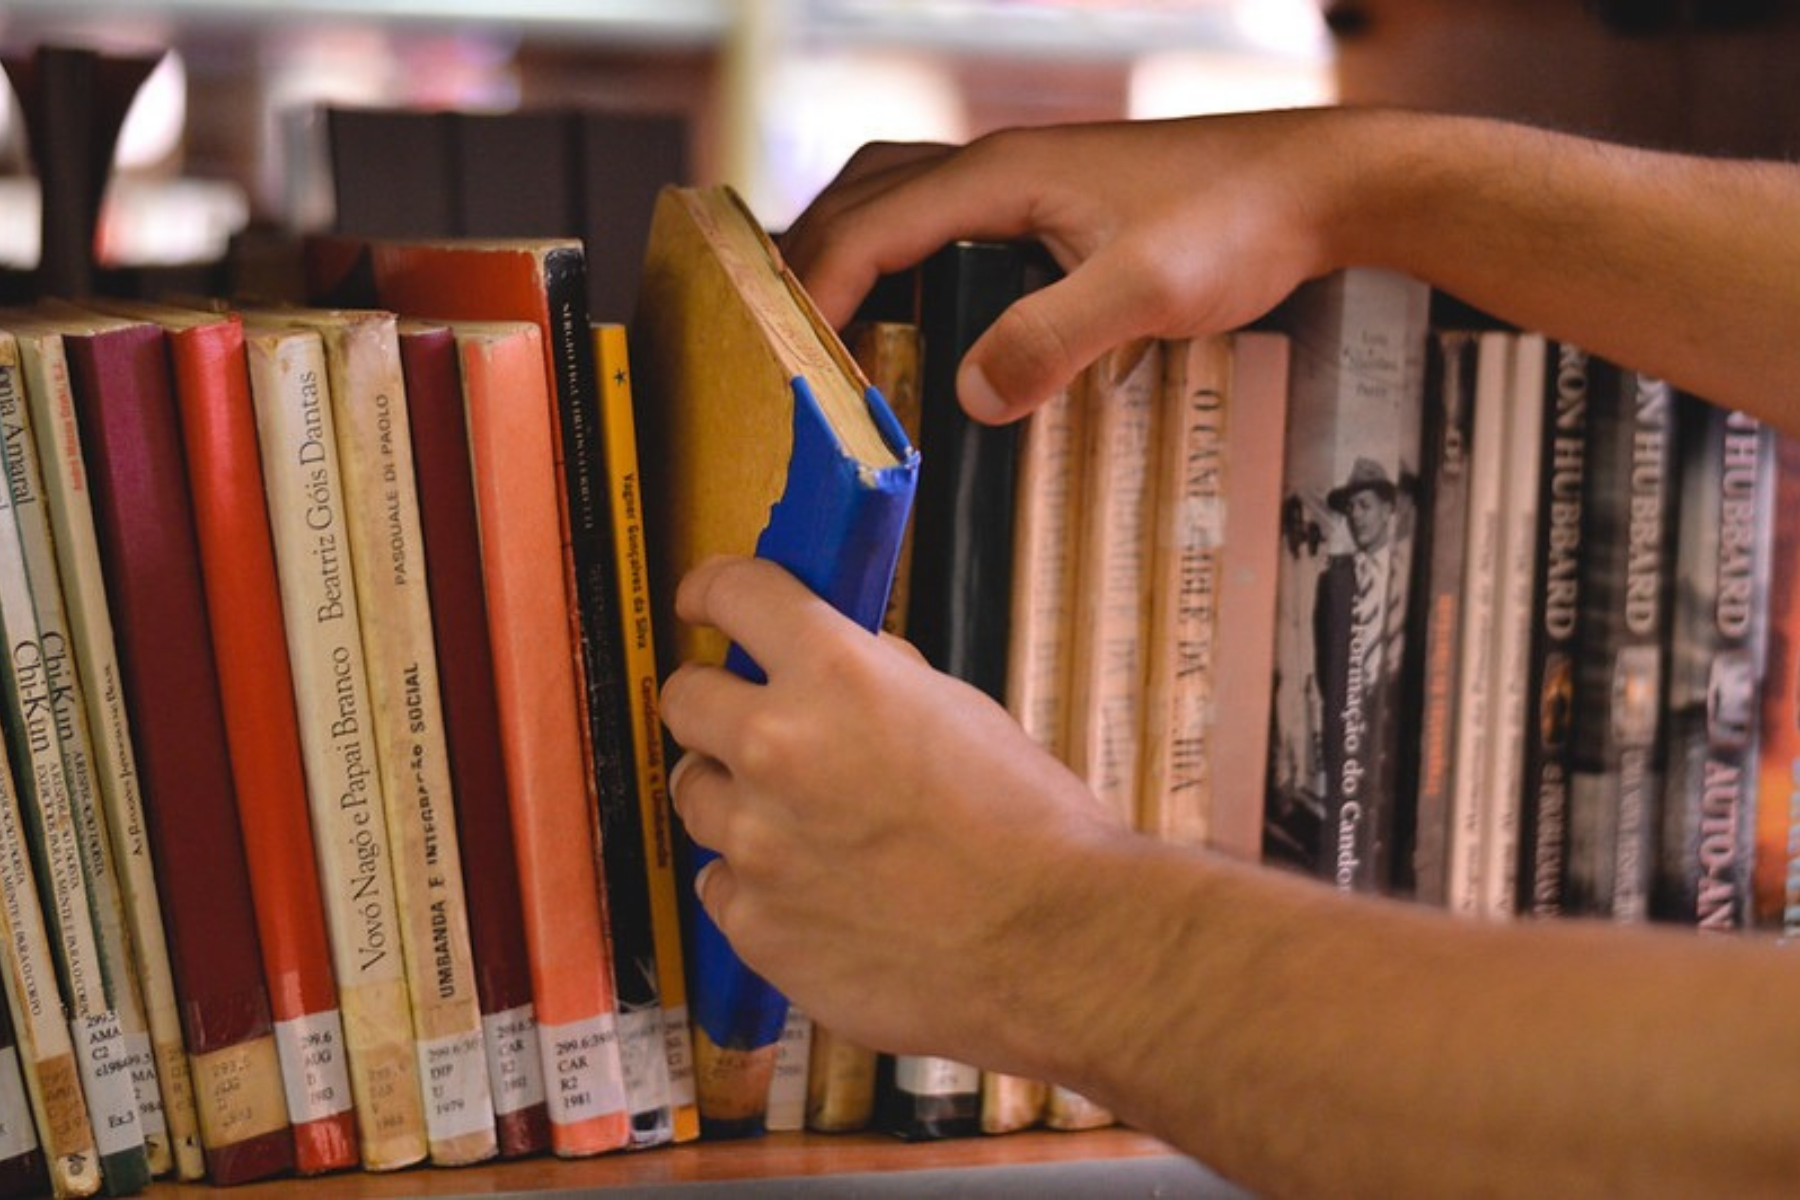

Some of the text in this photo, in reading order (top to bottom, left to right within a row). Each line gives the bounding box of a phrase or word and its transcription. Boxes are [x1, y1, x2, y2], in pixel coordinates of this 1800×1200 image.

[3, 423, 36, 505] Amaral
[300, 370, 344, 623] Beatriz Góis Dantas
[376, 393, 407, 586] PASQUALE DI PAOLO
[1546, 436, 1585, 640] HUBBARD
[1626, 430, 1664, 635] HUBBARD
[1716, 432, 1757, 639] HUBBARD
[13, 640, 50, 754] Chi-Kun
[40, 631, 75, 742] Chi-Kun
[331, 646, 358, 738] Branco
[403, 662, 425, 734] SOCIAL
[336, 742, 370, 810] Papai
[354, 811, 370, 826] e
[1342, 758, 1364, 794] do
[1337, 800, 1360, 893] Cando
[358, 902, 386, 971] Vovó
[430, 900, 455, 999] UMBANDA
[89, 1026, 122, 1045] AMA
[91, 1046, 110, 1062] C2
[556, 1055, 589, 1074] CAR
